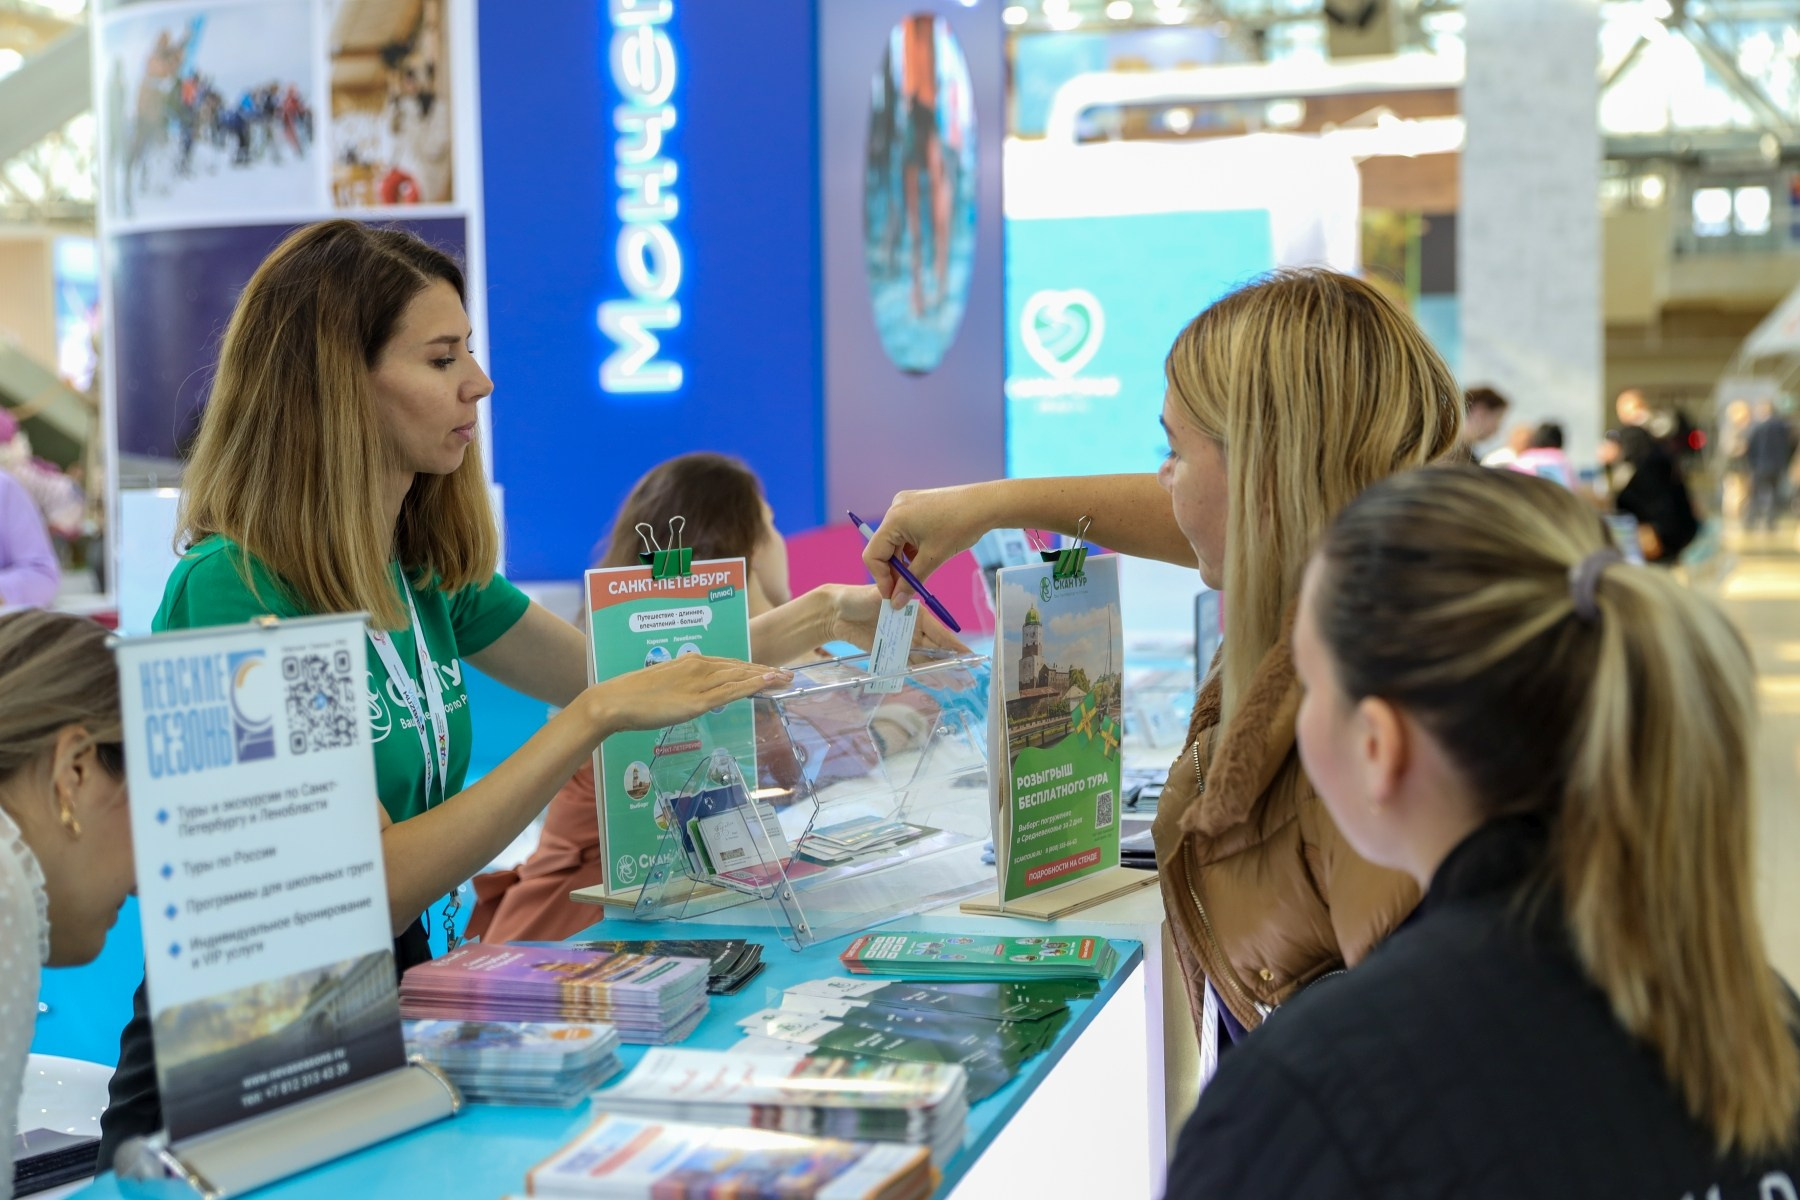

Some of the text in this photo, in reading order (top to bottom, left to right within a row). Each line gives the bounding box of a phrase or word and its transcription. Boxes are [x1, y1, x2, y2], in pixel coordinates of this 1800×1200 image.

[608, 571, 731, 595] САНКТ-ПЕТЕРБУРГ
[637, 612, 675, 623] Путешествие
[678, 609, 705, 619] длиннее,
[139, 654, 228, 711] НЕВСКИЕ
[1016, 763, 1073, 790] РОЗЫГРЫШ
[1018, 772, 1109, 810] БЕСПЛАТНОГО ТУРА
[177, 805, 209, 822] Туры
[222, 790, 282, 813] экскурсии
[284, 789, 299, 799] по
[300, 780, 338, 796] Санкт-
[178, 814, 247, 838] Петербургу
[260, 798, 328, 821] Ленобласти
[1018, 820, 1040, 832] Выборг:
[182, 845, 276, 879] Туры по России
[1028, 851, 1098, 882] ПОДРОБНОСТИ НА СТЕНДЕ
[185, 859, 375, 916] Программы для школьных групп
[189, 897, 373, 951] Индивидуальное бронирование
[201, 950, 223, 968] VIP
[226, 940, 265, 961] услуги
[281, 1078, 300, 1095] 812
